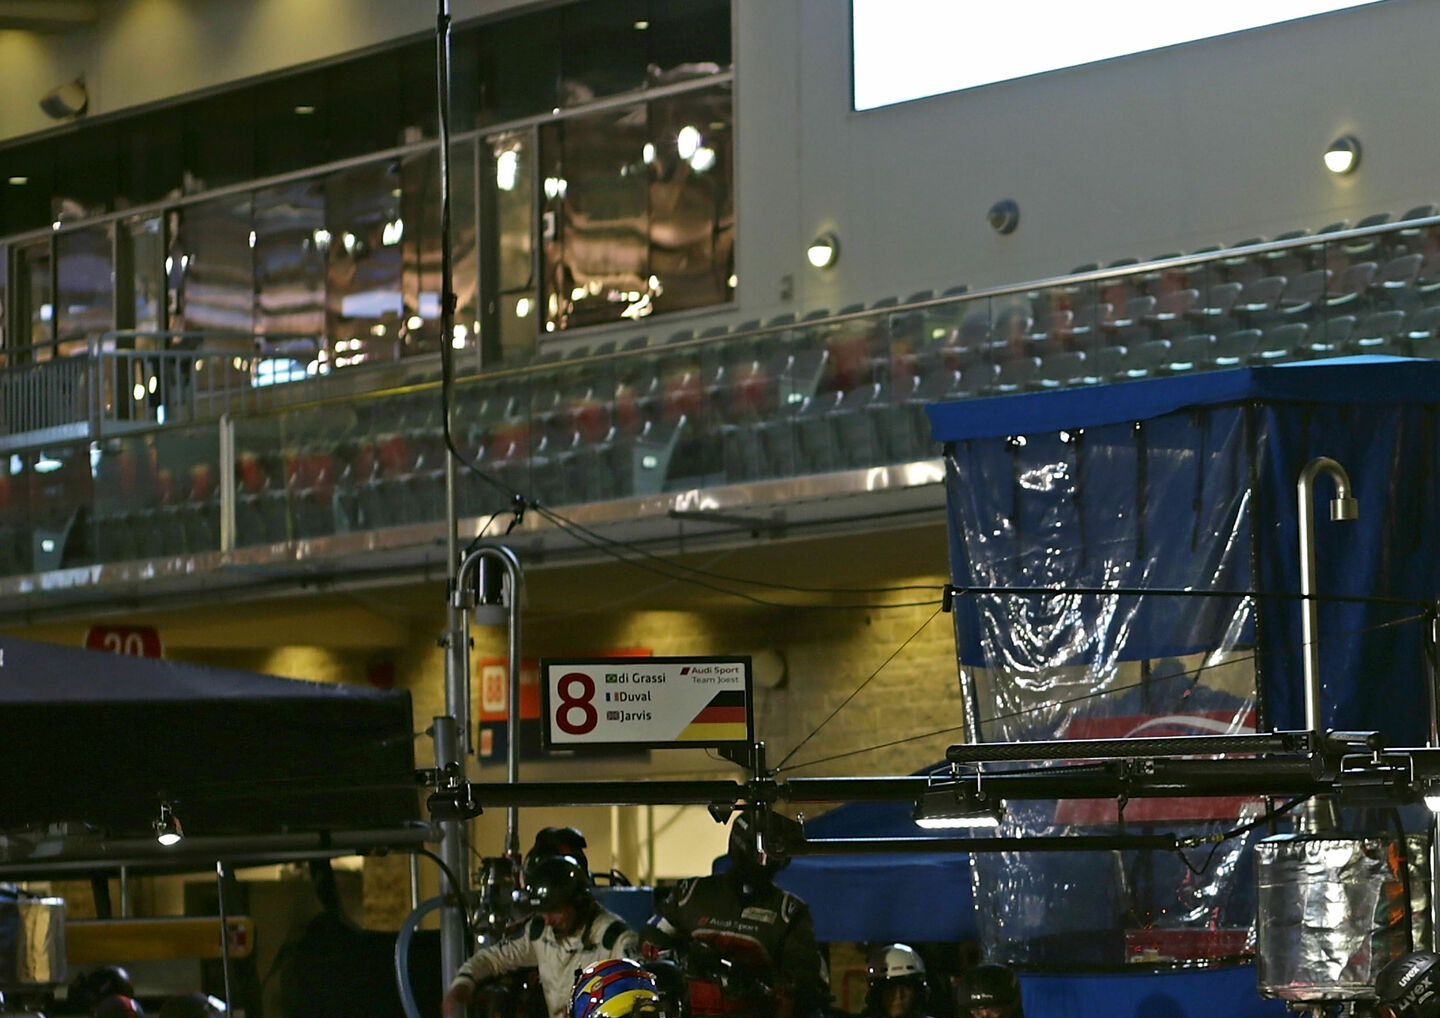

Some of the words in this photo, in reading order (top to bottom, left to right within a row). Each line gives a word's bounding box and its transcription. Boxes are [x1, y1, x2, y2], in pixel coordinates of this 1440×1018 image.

[691, 667, 712, 675] Audi
[714, 667, 739, 676] Sport
[618, 673, 629, 683] di
[632, 673, 666, 683] Grassi
[619, 692, 652, 702] Duval
[556, 673, 598, 735] 8
[620, 711, 652, 723] Jarvis
[1399, 966, 1420, 988] uvex
